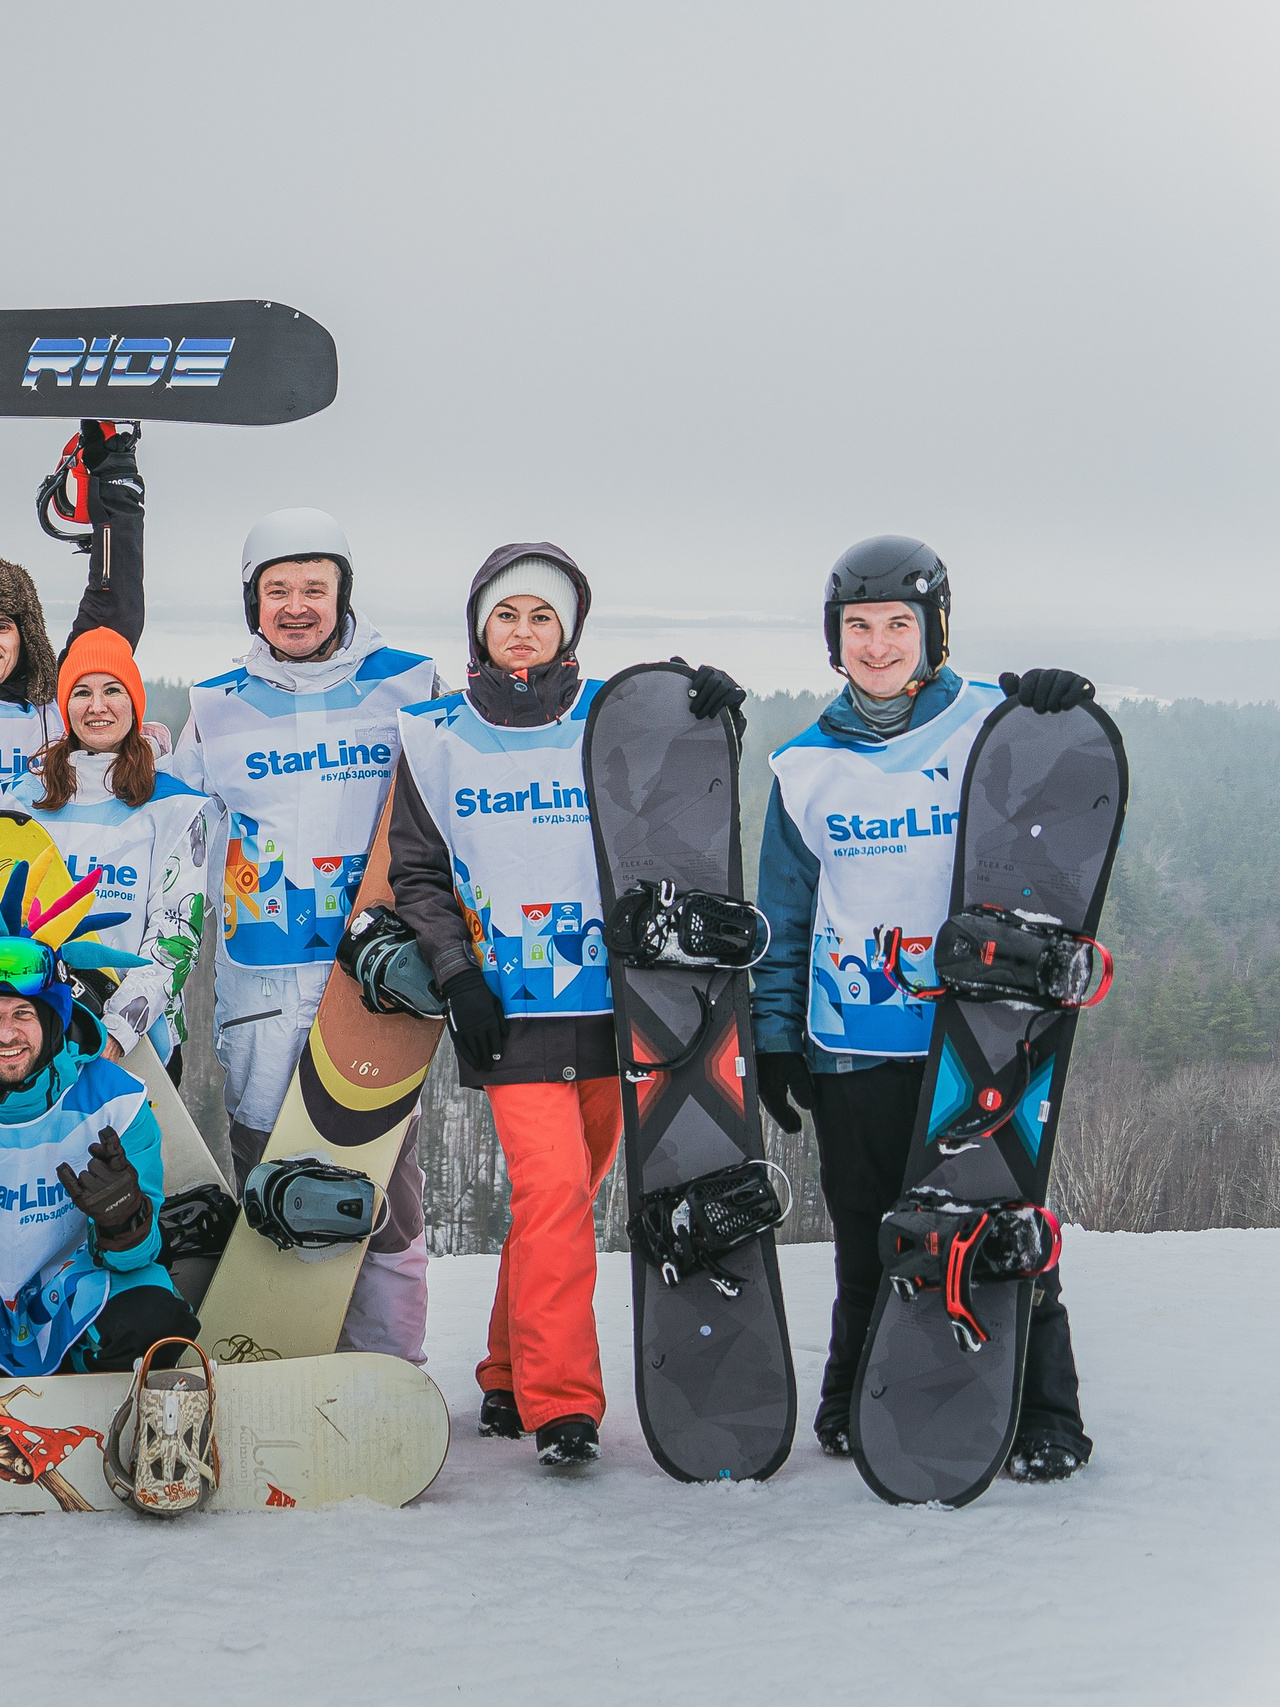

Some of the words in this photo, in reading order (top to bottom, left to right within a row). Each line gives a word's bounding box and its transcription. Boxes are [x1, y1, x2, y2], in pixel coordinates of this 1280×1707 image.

[21, 337, 236, 387] RIDE
[245, 739, 392, 781] StarLine
[320, 769, 392, 782] #БУДЬЗДОРОВ!
[454, 781, 590, 818] StarLin
[833, 845, 908, 857] #БУДЬЗДОРОВ!
[64, 854, 138, 887] Line
[350, 1060, 380, 1077] 160
